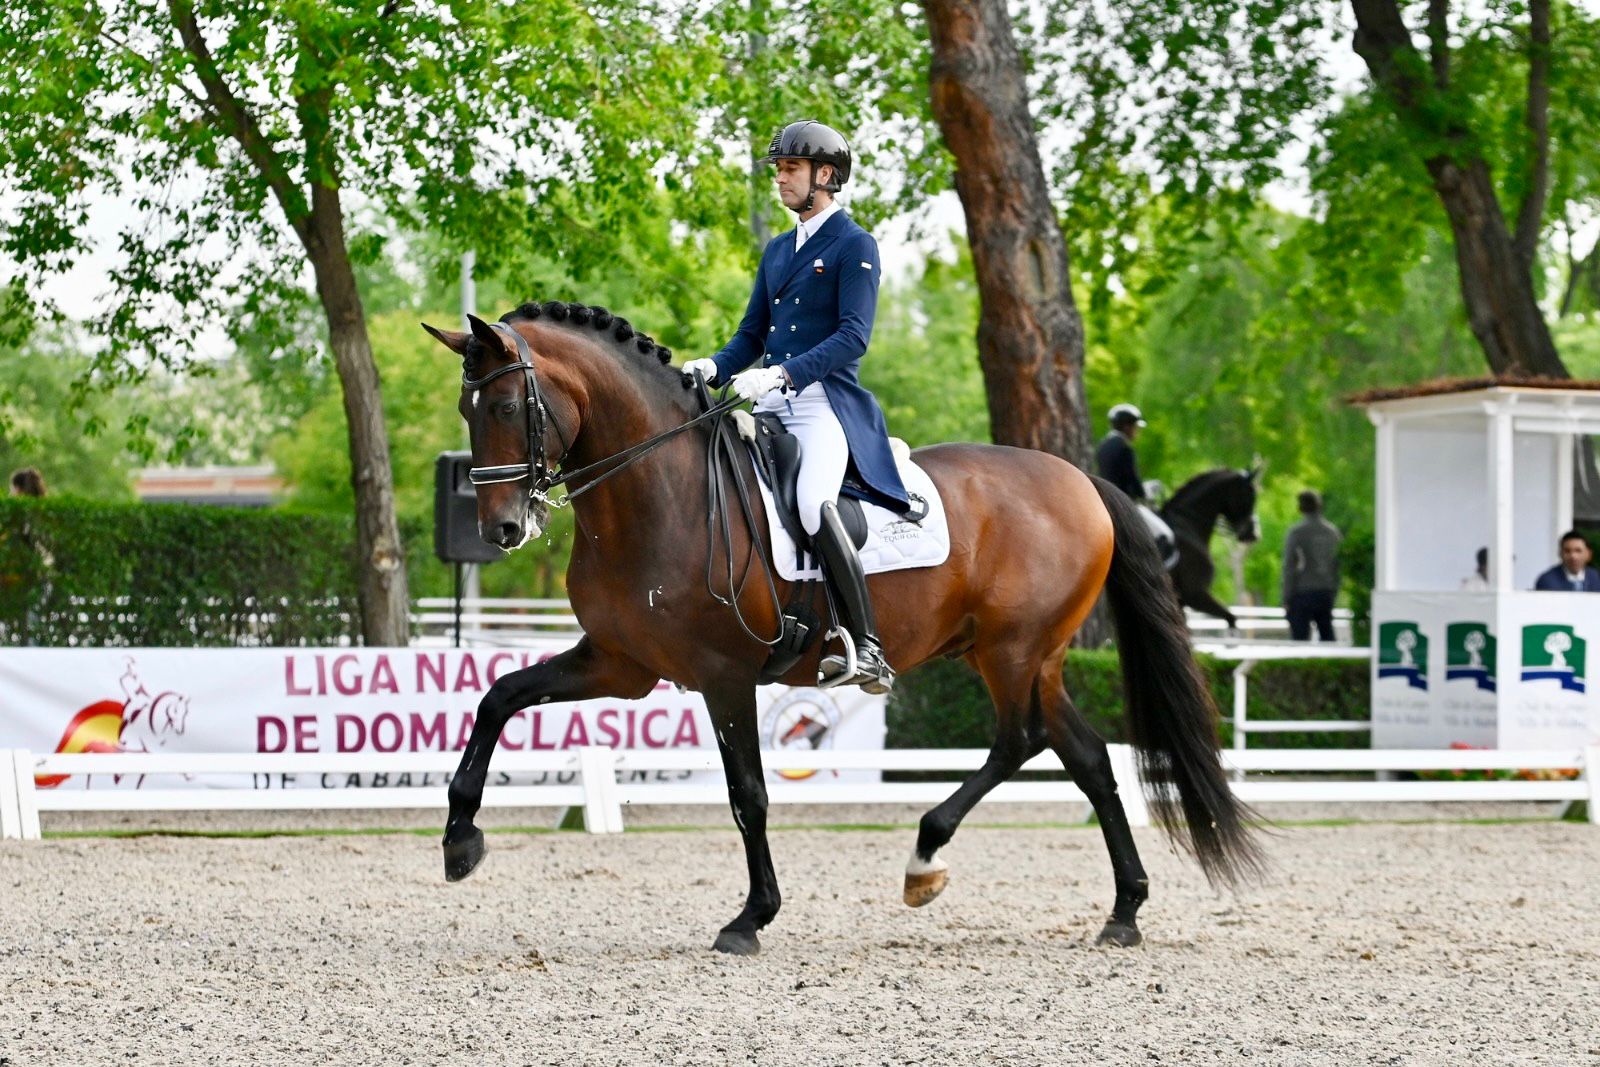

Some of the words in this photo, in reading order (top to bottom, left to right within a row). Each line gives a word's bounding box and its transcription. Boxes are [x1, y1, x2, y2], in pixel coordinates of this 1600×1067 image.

[284, 653, 400, 696] LIGA
[257, 714, 320, 754] DE
[335, 712, 476, 754] DOMA
[498, 703, 701, 752] CLÁSICA
[321, 771, 511, 788] CABALLS
